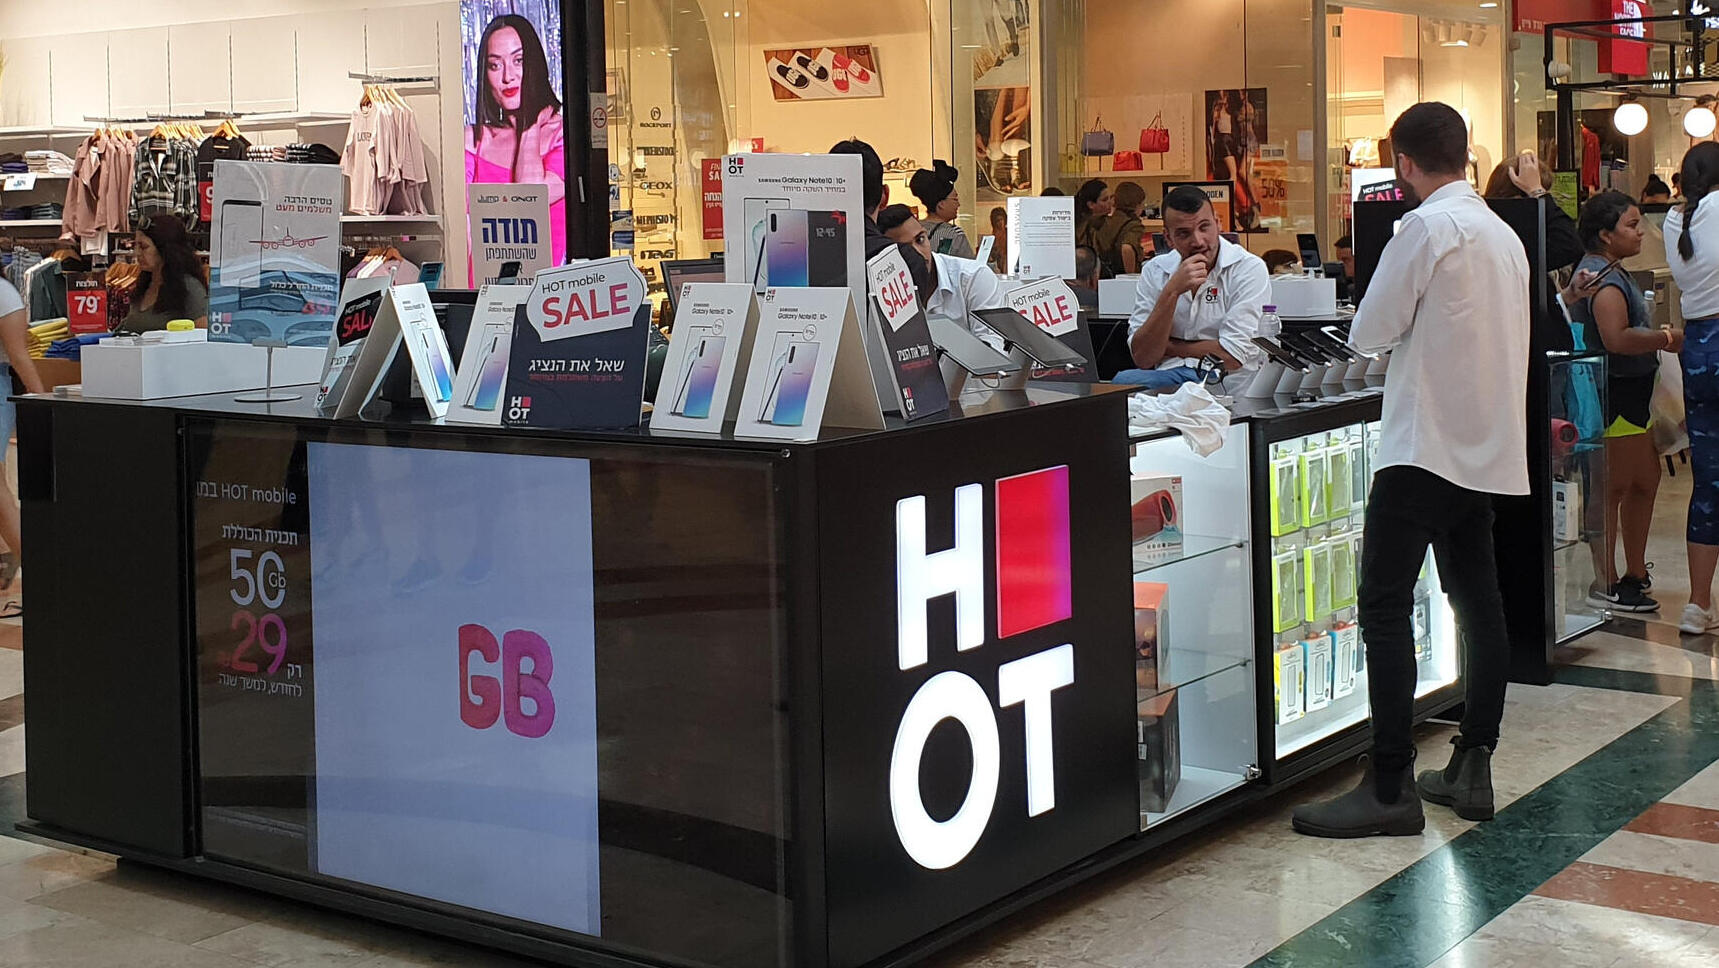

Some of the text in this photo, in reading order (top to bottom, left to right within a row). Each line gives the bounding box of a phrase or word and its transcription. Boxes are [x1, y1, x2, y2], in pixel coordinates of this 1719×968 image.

[640, 182, 673, 190] GEOX
[781, 176, 807, 185] Galaxy
[1261, 178, 1285, 198] 50%
[284, 195, 308, 204] הרבה
[482, 218, 538, 244] תודה
[486, 248, 537, 261] שהשתתפתן
[542, 280, 566, 294] HOT
[568, 273, 606, 289] mobile
[881, 270, 913, 318] SALE
[1012, 288, 1051, 308] HOT mobile
[542, 282, 631, 329] SALE
[777, 312, 798, 320] Galaxy
[528, 357, 625, 372] שאל את הנציג
[222, 483, 249, 500] HOT
[252, 487, 297, 504] mobile
[222, 523, 298, 545] תכנית הכוללת
[230, 548, 287, 609] 50 Gb
[231, 609, 302, 679] רק 29
[218, 673, 239, 688] שנה
[458, 623, 556, 738] GB
